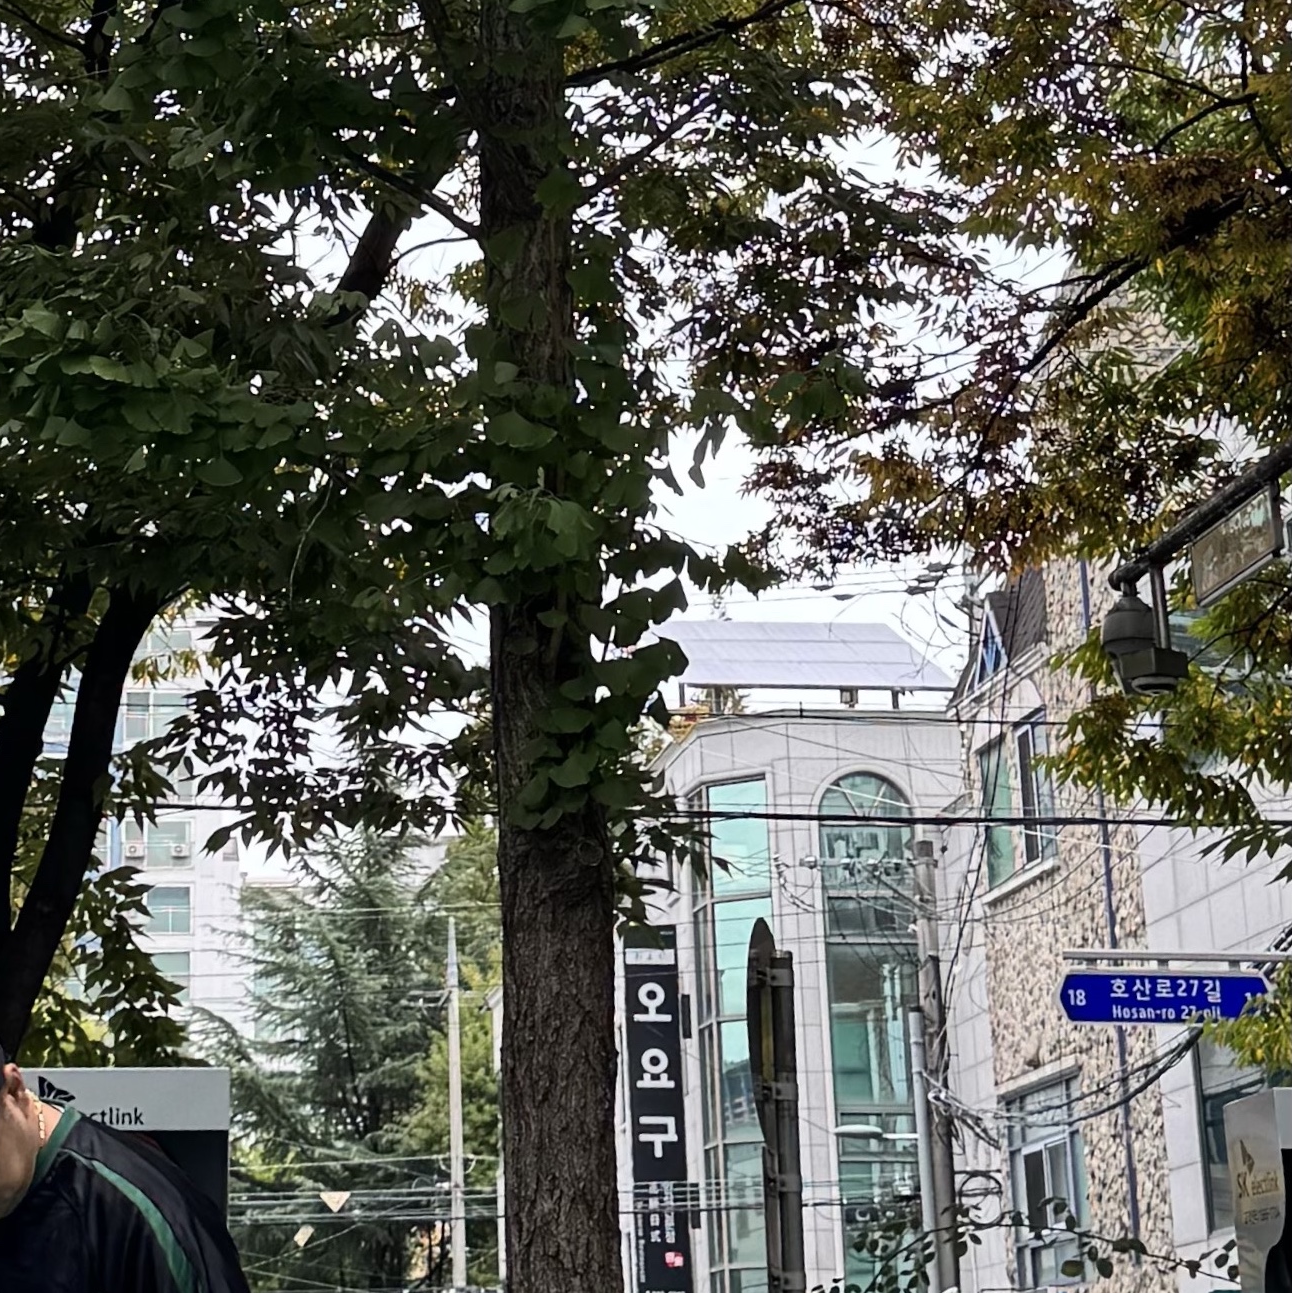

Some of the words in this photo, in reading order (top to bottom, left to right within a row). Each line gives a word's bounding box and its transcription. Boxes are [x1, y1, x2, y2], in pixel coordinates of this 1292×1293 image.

[1068, 989, 1087, 1006] 18
[1110, 978, 1221, 1003] 호산로27길
[1112, 1004, 1176, 1020] Hosan-ro
[633, 981, 678, 1158] 오요구
